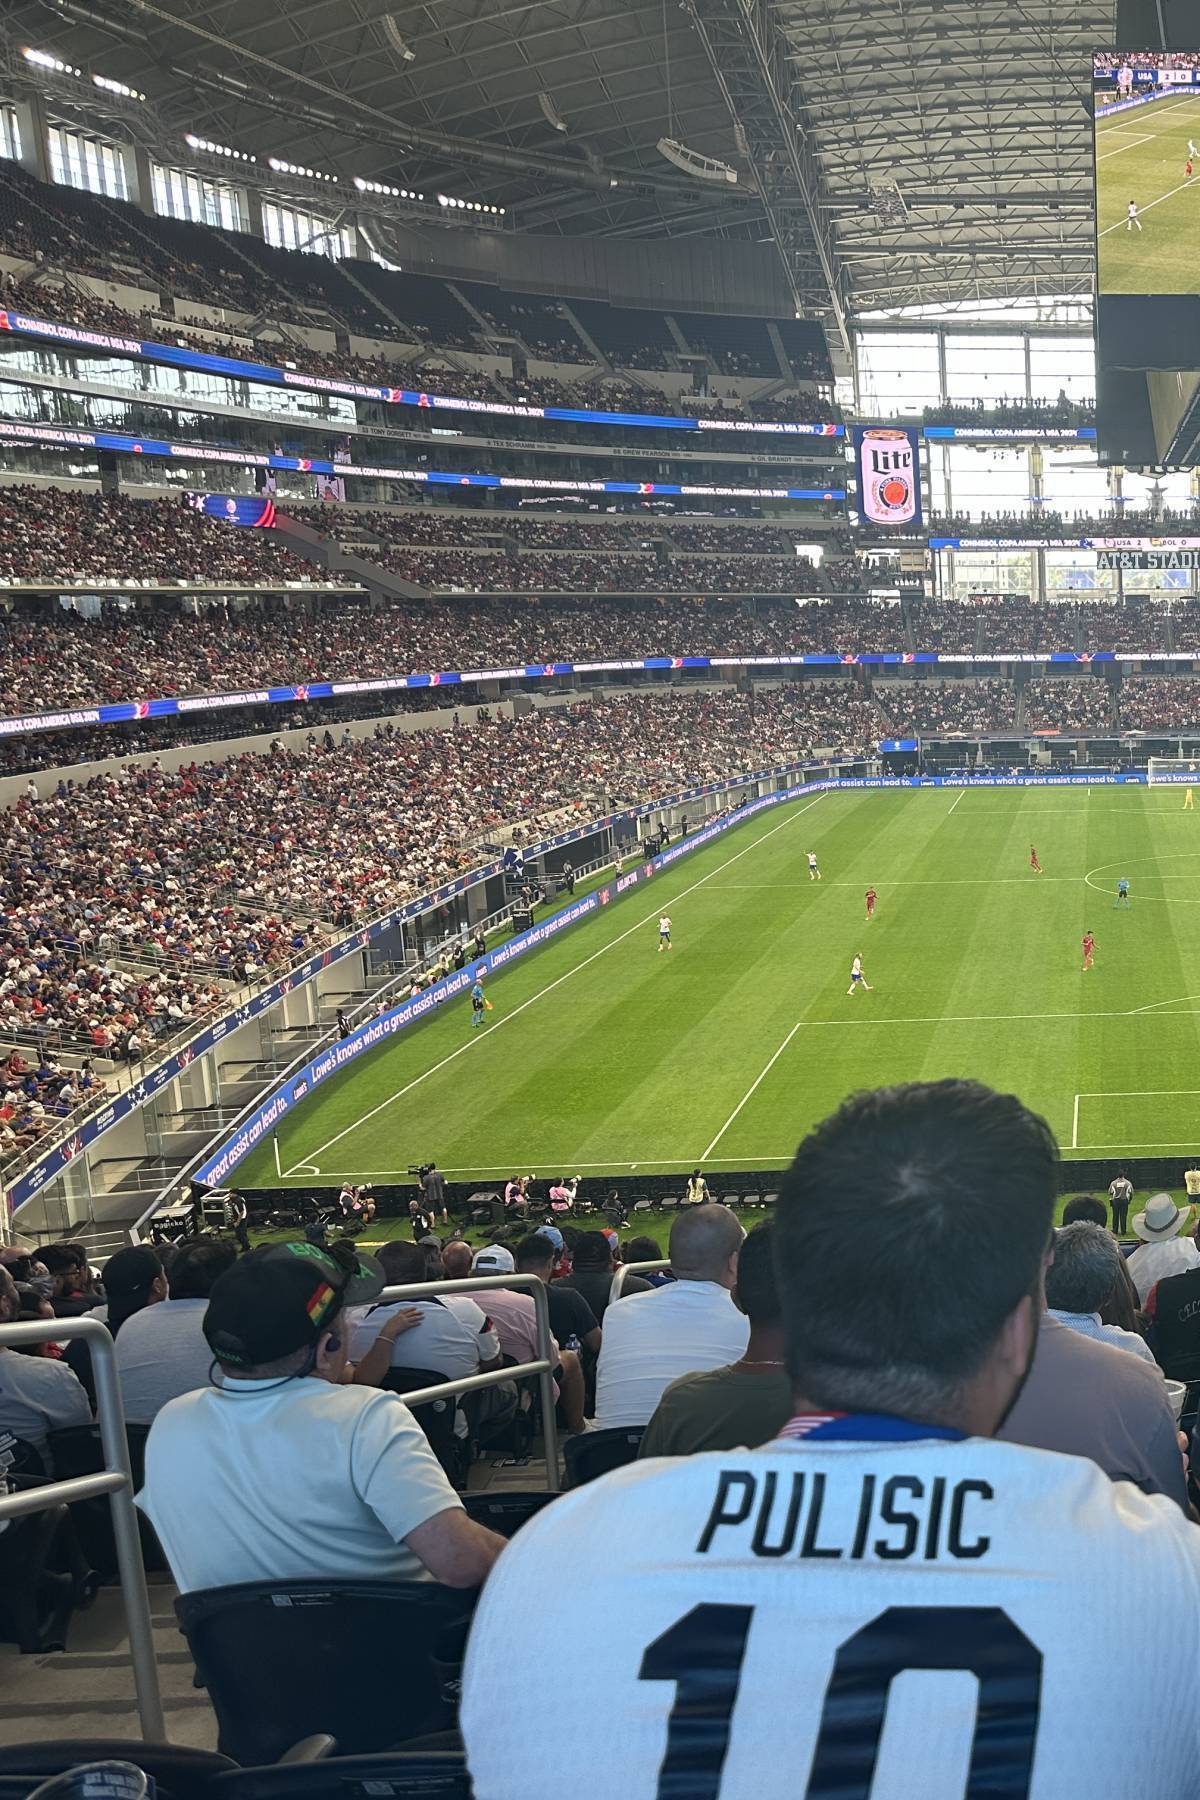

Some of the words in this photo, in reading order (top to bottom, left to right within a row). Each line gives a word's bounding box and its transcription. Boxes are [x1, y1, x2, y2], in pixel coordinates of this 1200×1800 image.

[1138, 72, 1153, 80] USA
[871, 449, 911, 475] Lite
[1100, 552, 1142, 569] AT&T
[882, 778, 900, 786] lead
[942, 777, 967, 785] Lowe's
[969, 777, 994, 785] knows
[1024, 778, 1046, 786] great
[1047, 776, 1070, 784] assist
[1173, 774, 1197, 782] knows
[490, 949, 510, 968] Lowe's
[509, 940, 527, 956] knows
[526, 930, 540, 947] what
[544, 919, 558, 937] great
[557, 912, 572, 928] assist
[571, 908, 581, 920] can
[580, 901, 590, 914] lead
[311, 1051, 337, 1083] Lowe's
[336, 1038, 363, 1065] knows
[362, 1023, 383, 1048] what
[383, 1019, 390, 1031] a
[391, 1010, 413, 1031] great
[412, 995, 434, 1016] assist
[433, 990, 447, 1003] can
[446, 980, 462, 999] lead
[460, 974, 471, 989] to.
[207, 1153, 229, 1188] great
[229, 1130, 250, 1162] assist
[247, 1123, 263, 1143] can
[261, 1107, 278, 1132] lead
[276, 1097, 288, 1117] to.
[695, 1470, 994, 1560] PULISIC
[638, 1602, 1044, 1800] 10
